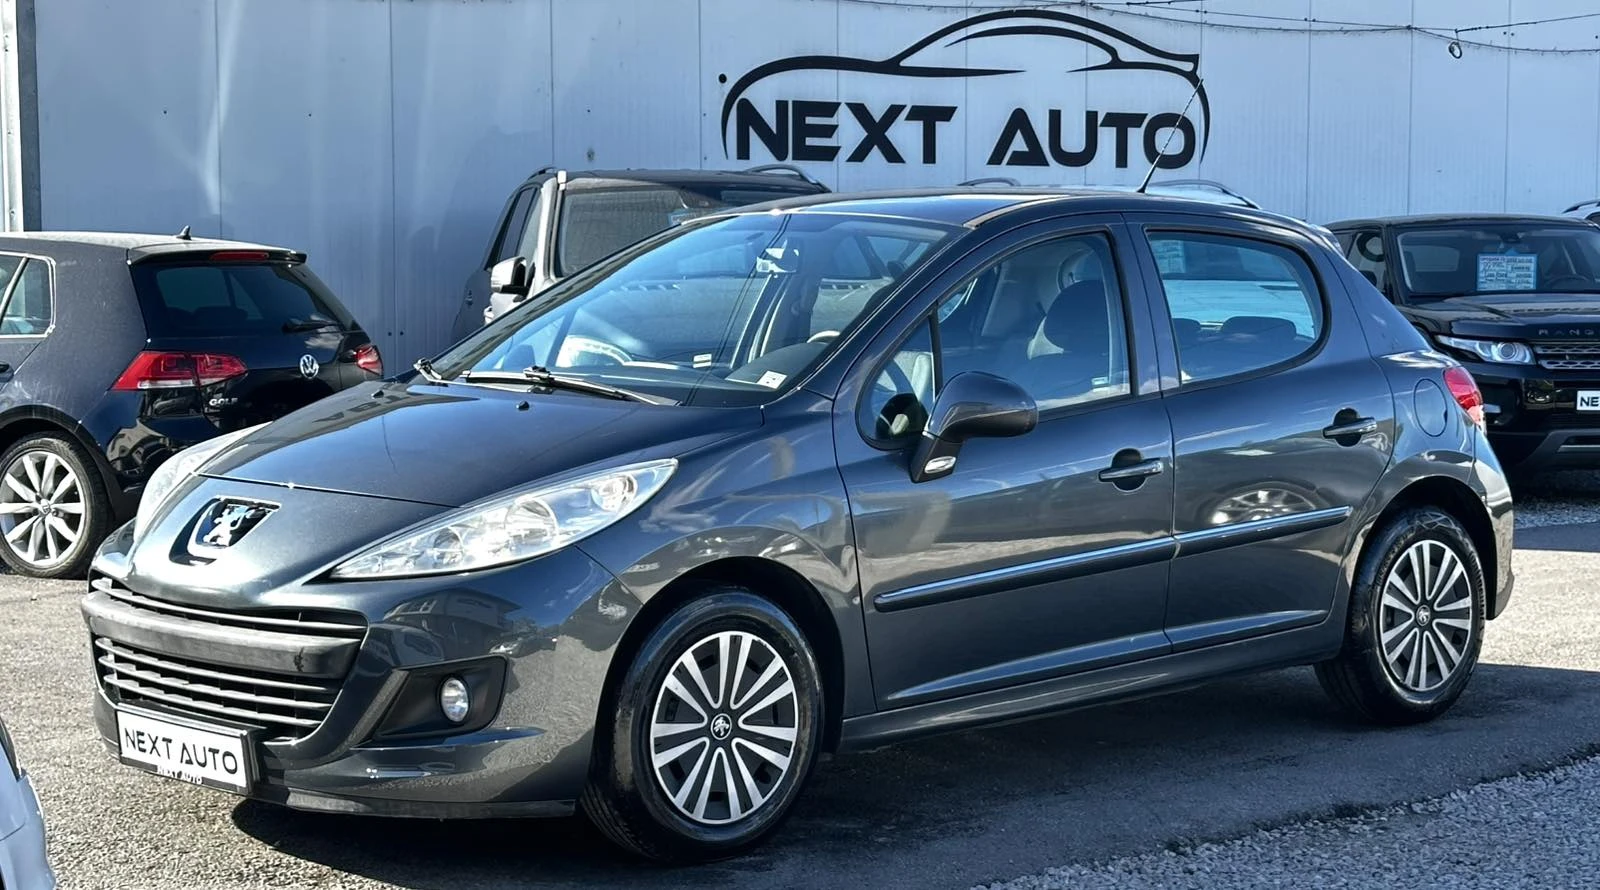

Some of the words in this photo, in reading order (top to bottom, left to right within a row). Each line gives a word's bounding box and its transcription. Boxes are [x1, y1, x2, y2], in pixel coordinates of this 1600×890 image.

[736, 97, 958, 165] NEXT
[986, 106, 1197, 171] AUTO
[208, 397, 238, 406] GOLF
[124, 727, 173, 760] NEXT
[180, 742, 238, 775] AUTO
